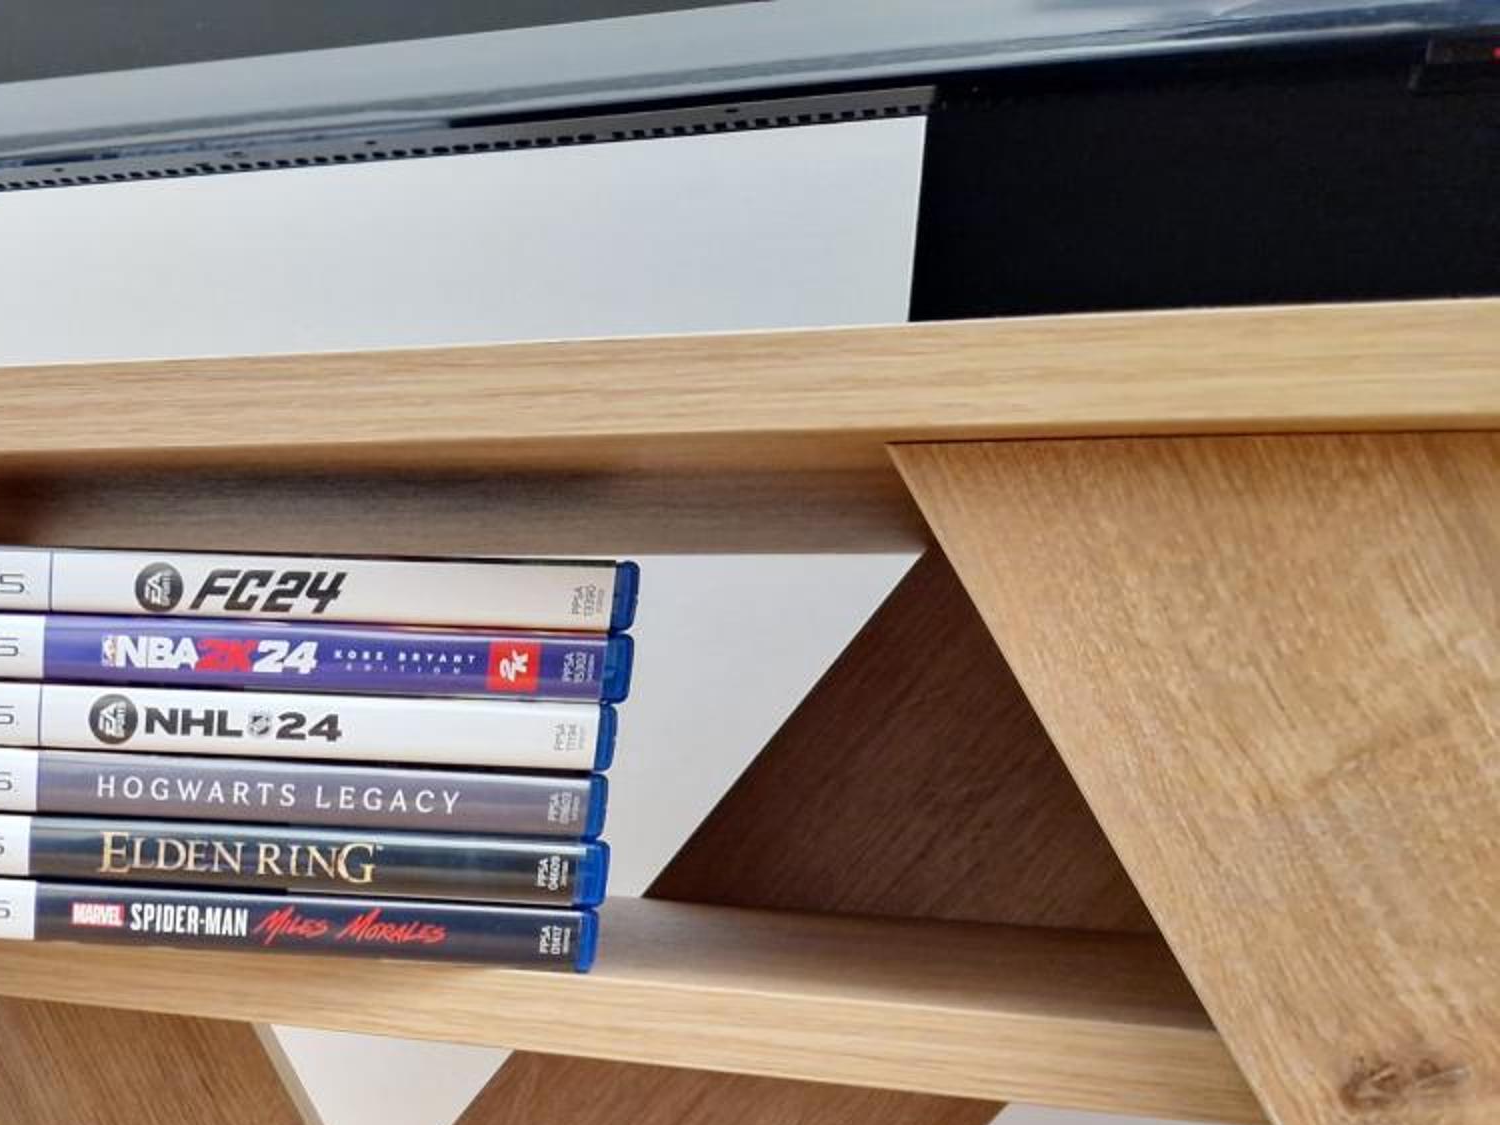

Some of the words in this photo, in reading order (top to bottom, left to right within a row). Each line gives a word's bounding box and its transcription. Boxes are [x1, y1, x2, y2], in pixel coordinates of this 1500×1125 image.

[334, 649, 384, 661] KOBE
[398, 652, 476, 664] BRYANT
[144, 707, 244, 738] NHL
[275, 711, 343, 742] 24
[96, 774, 297, 808] HOGWARTS
[314, 785, 461, 815] LEGACY
[99, 831, 245, 875] ELDEN
[256, 841, 377, 884] RING
[71, 902, 124, 927] MARVEL
[130, 903, 249, 937] SPIDER-MAN
